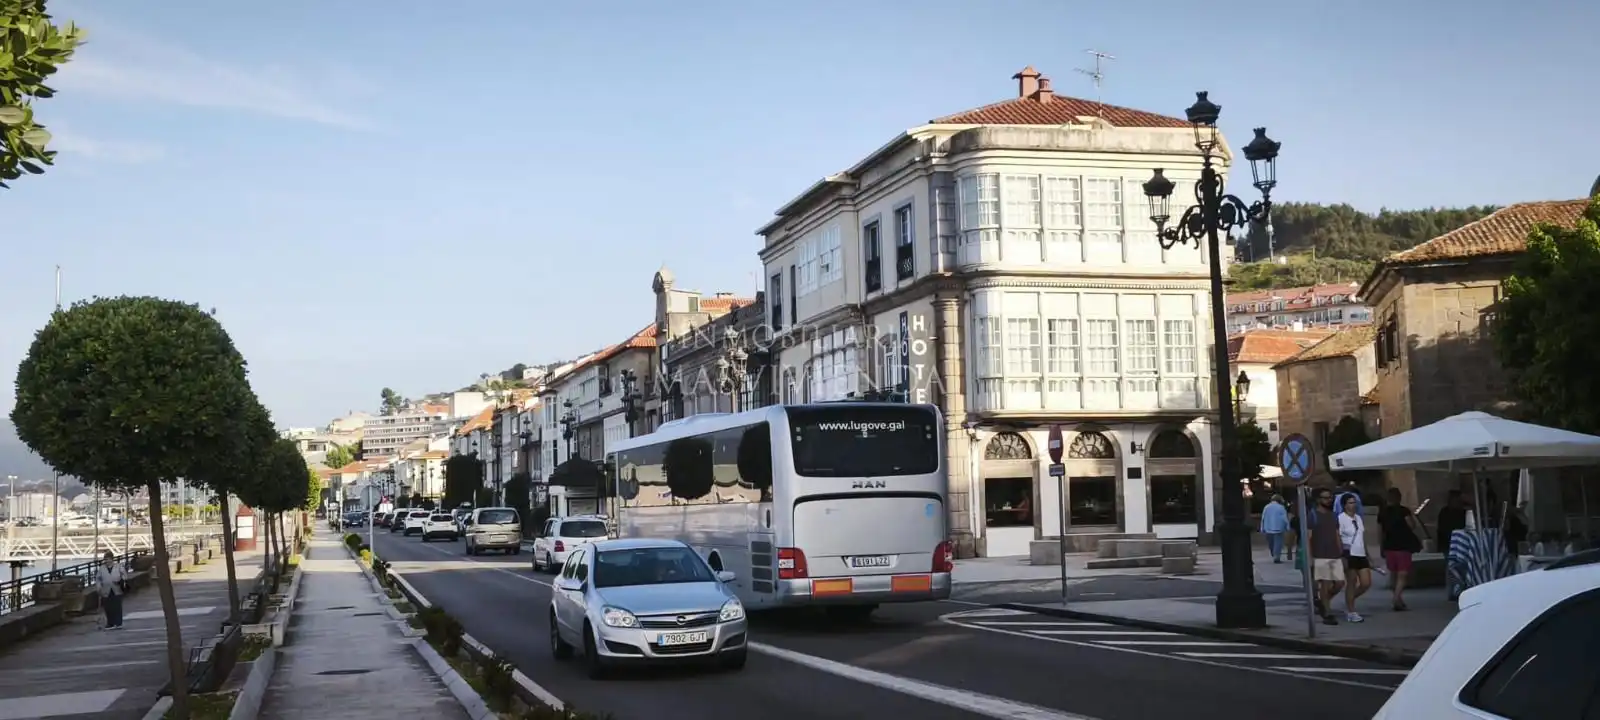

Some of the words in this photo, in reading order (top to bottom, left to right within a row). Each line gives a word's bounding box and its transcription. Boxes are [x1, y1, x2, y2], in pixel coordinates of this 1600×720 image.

[818, 420, 905, 432] www.lugove.gal
[851, 480, 887, 489] MAN
[665, 633, 686, 644] 7902
[690, 632, 705, 642] GJT
